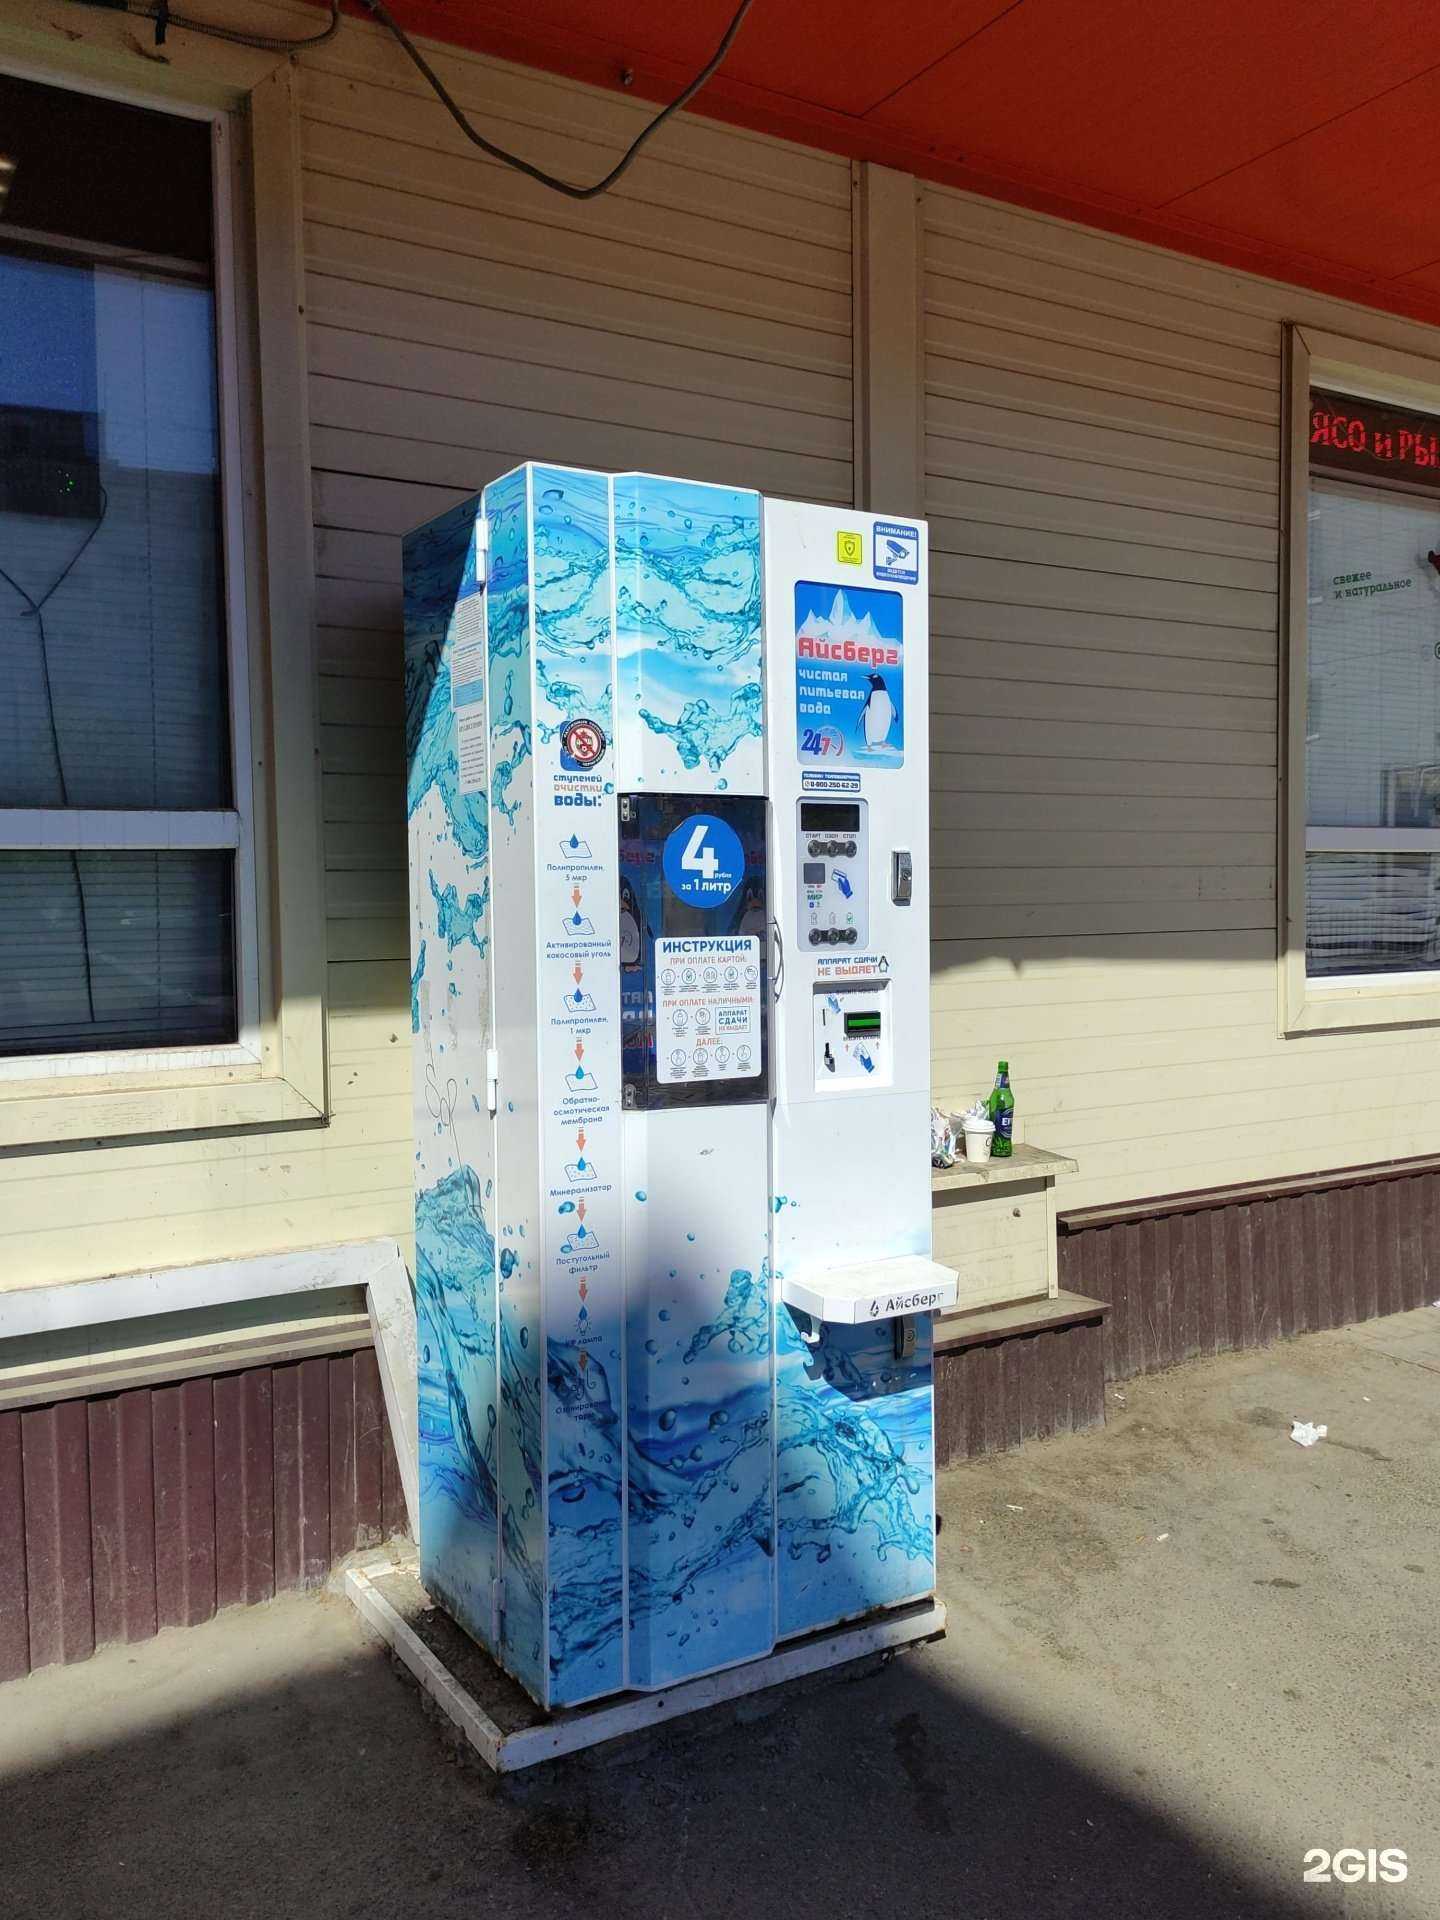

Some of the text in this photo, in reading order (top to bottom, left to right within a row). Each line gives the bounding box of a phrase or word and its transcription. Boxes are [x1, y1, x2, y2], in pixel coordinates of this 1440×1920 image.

[1399, 430, 1440, 468] РЫ
[1332, 570, 1372, 586] свежее
[1334, 578, 1412, 599] и натуральное
[799, 668, 848, 682] чистая
[799, 685, 865, 700] питьевая
[800, 701, 831, 715] вода
[553, 774, 602, 783] ступеней
[553, 783, 602, 792] очистки
[554, 792, 602, 807] воды:
[681, 825, 719, 879] 4
[693, 878, 700, 891] 1
[701, 880, 732, 894] литр
[546, 939, 612, 949] Активированный
[662, 939, 752, 954] ИНСТРУКЦИЯ
[591, 951, 612, 959] уголь
[670, 957, 686, 965] ПРИ
[687, 956, 716, 965] ОПЛАТЕ
[817, 956, 878, 965] АППАРАТ СДАЧИ
[817, 964, 878, 976] НЕ ВЫДАЕТ
[662, 999, 679, 1008] ПРИ
[679, 998, 705, 1007] ОПЛАТЕ
[718, 1016, 748, 1025] СДАЧИ
[553, 1105, 610, 1116] осмотическая
[560, 1116, 603, 1126] мембрана
[549, 1183, 612, 1197] Минерализатор
[568, 1264, 598, 1274] фильтр
[885, 1290, 944, 1312] Айсберг
